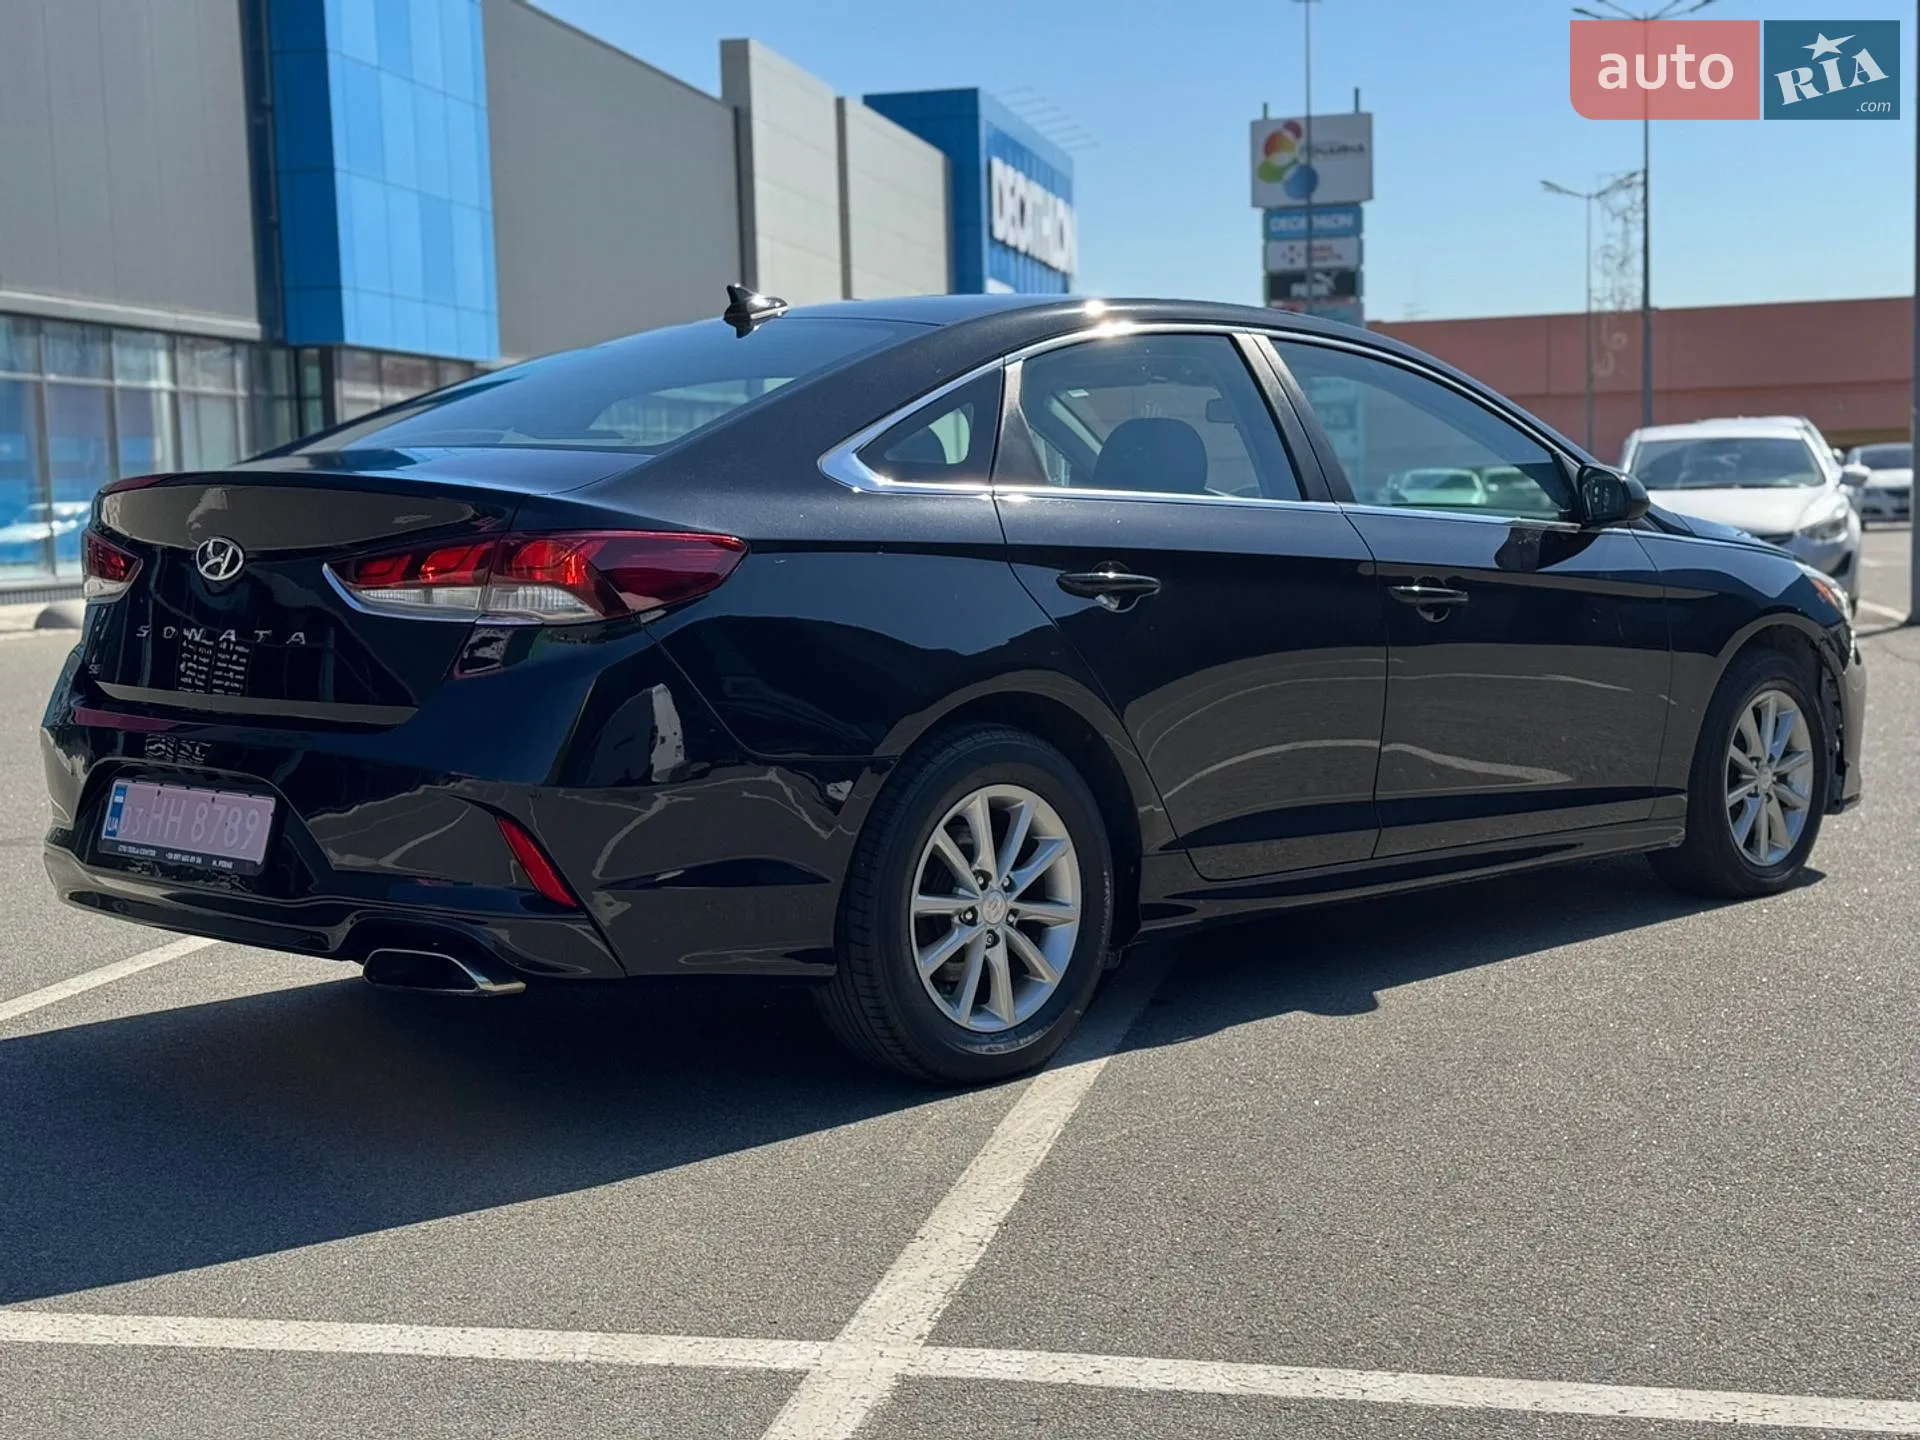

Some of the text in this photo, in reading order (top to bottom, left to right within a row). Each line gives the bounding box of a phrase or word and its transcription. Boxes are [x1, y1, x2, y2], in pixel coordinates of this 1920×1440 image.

[135, 625, 307, 645] SONATA
[107, 816, 119, 832] UA
[191, 801, 261, 850] 8789
